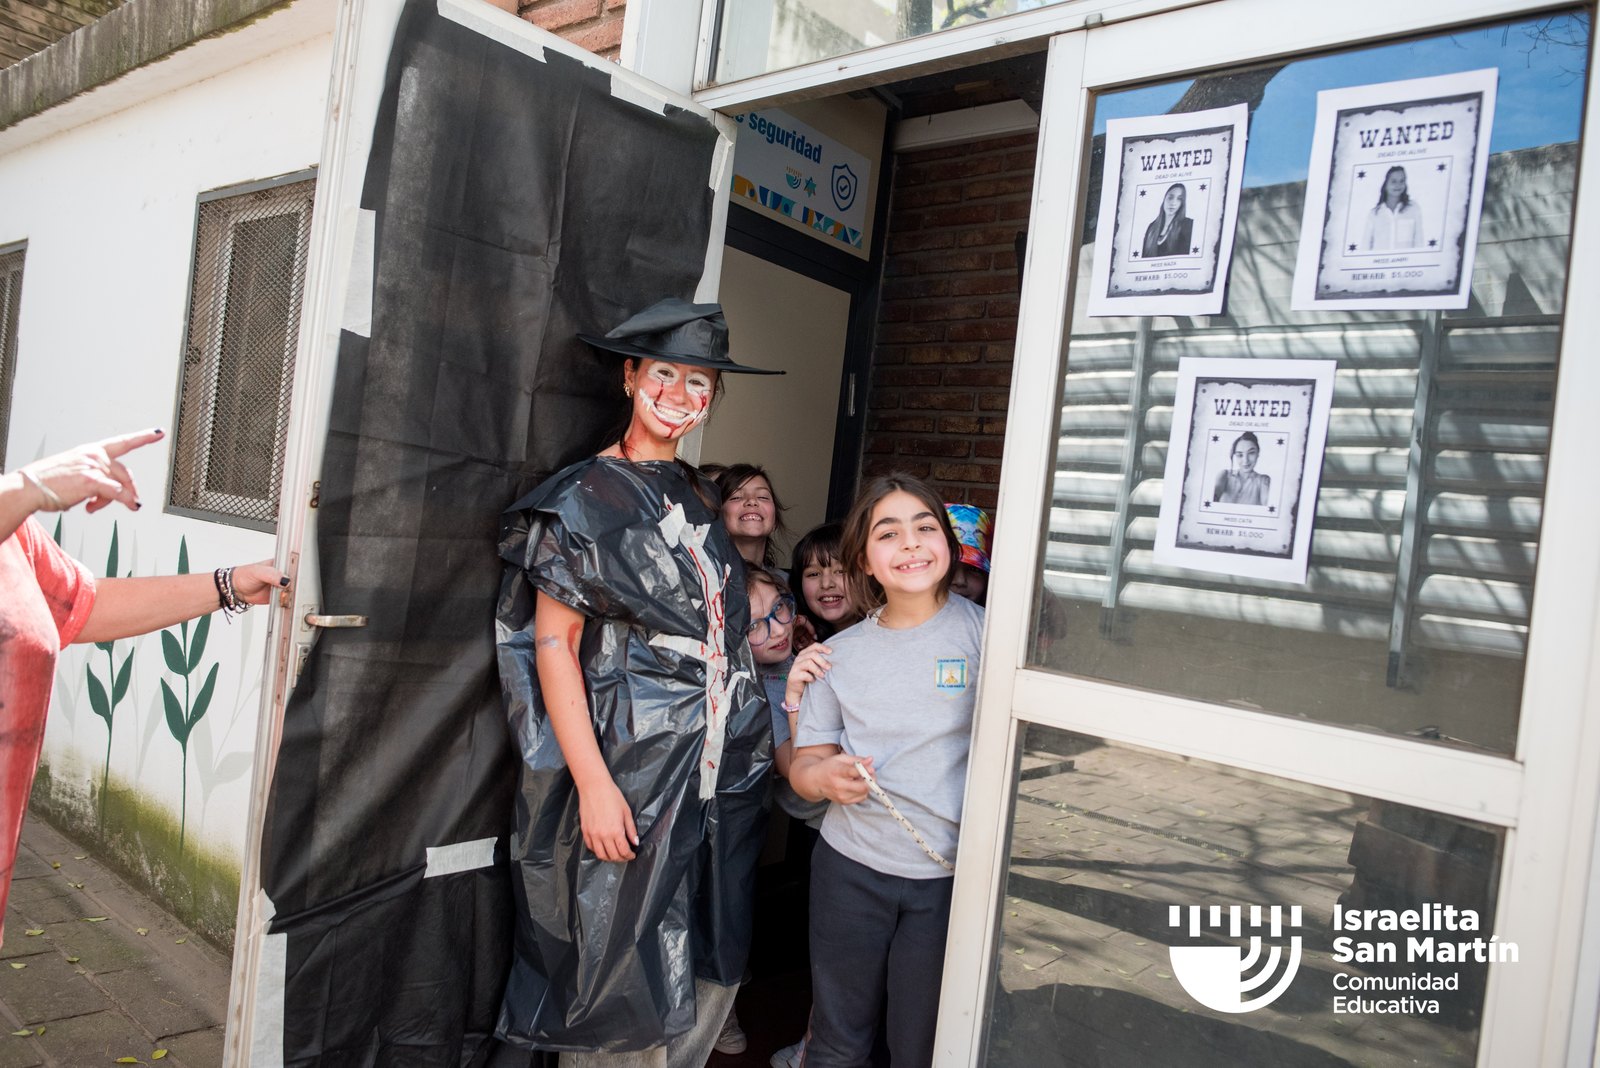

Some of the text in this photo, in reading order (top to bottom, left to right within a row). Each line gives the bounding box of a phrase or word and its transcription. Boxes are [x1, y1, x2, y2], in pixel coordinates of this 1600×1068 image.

[749, 112, 822, 164] seguridad
[1359, 120, 1455, 148] WANTED
[1141, 148, 1213, 171] WANTED
[1214, 398, 1291, 418] WANTED
[1206, 527, 1234, 537] REWARD
